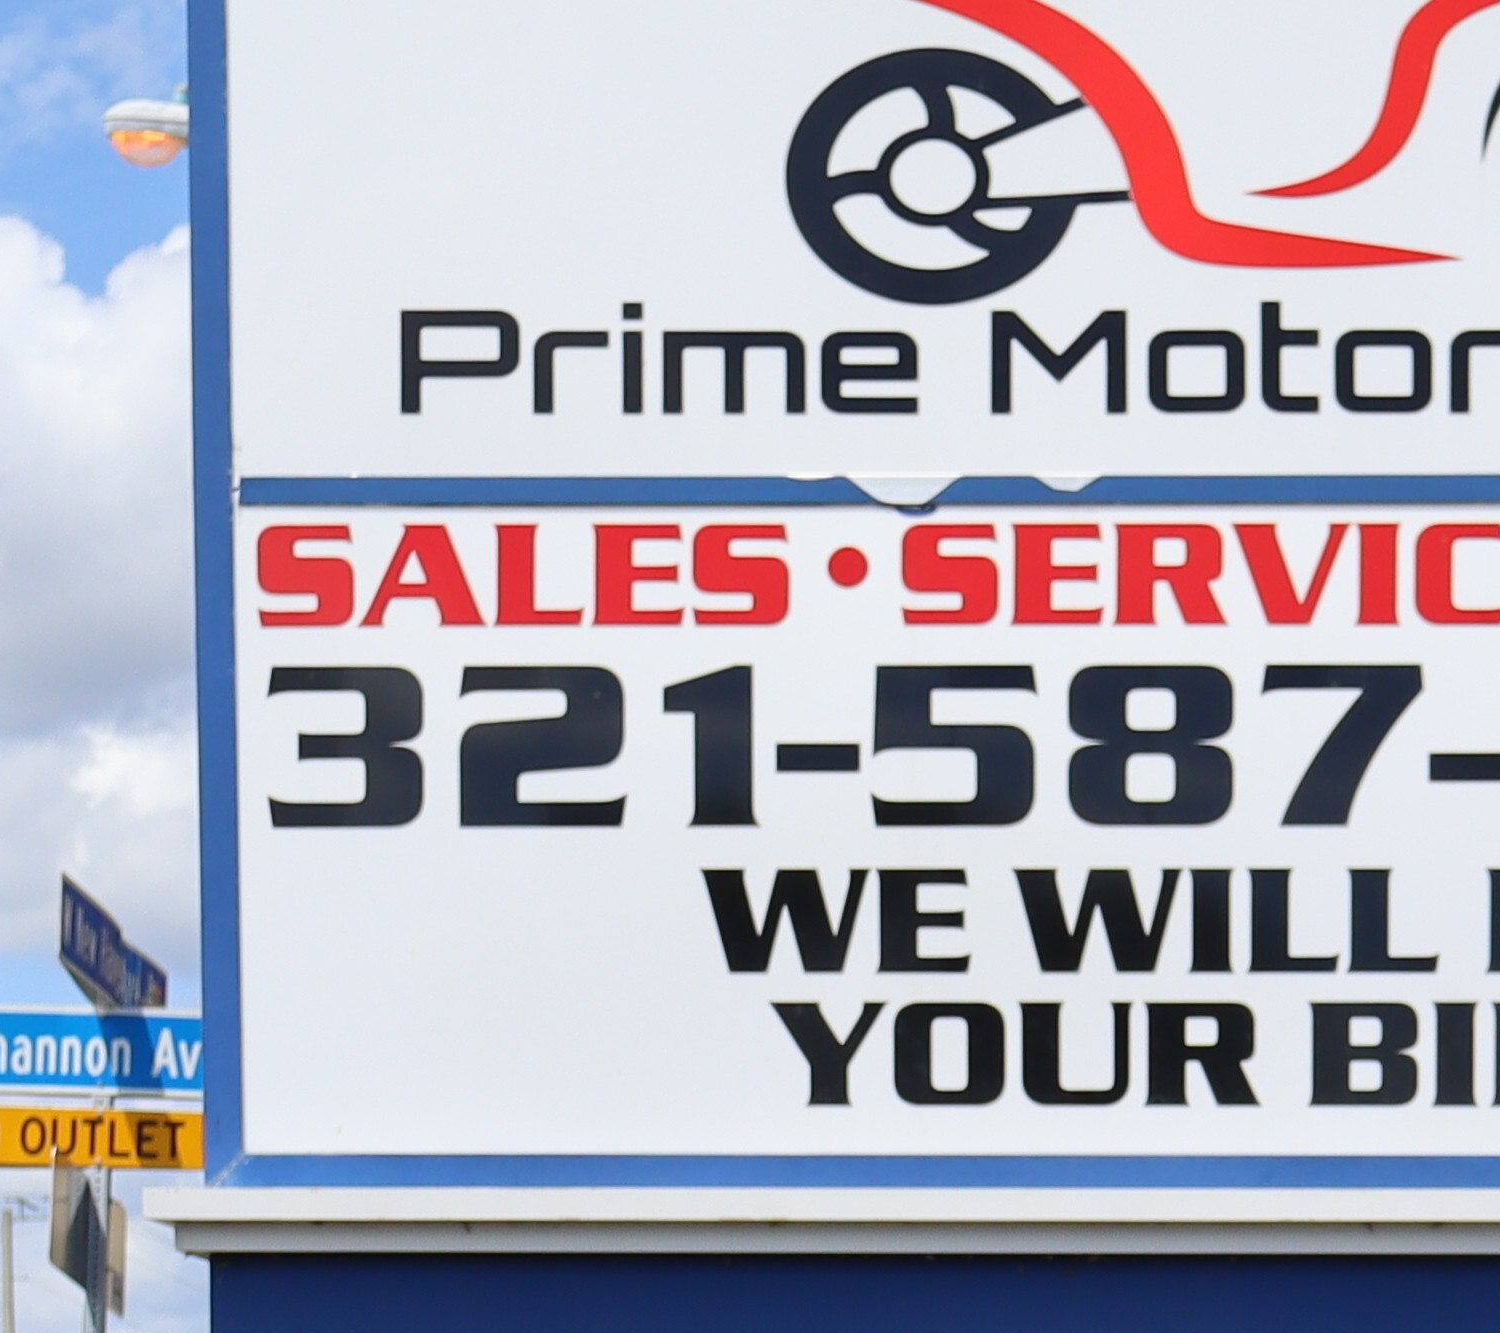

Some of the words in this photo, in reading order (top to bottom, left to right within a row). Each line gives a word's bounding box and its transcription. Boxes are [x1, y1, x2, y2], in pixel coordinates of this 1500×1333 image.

[401, 301, 919, 415] Prime
[257, 522, 790, 627] SALES
[702, 867, 970, 974] WE
[1014, 867, 1438, 974] WILL
[771, 1001, 1260, 1107] YOUR
[19, 1116, 186, 1160] OUTLET
